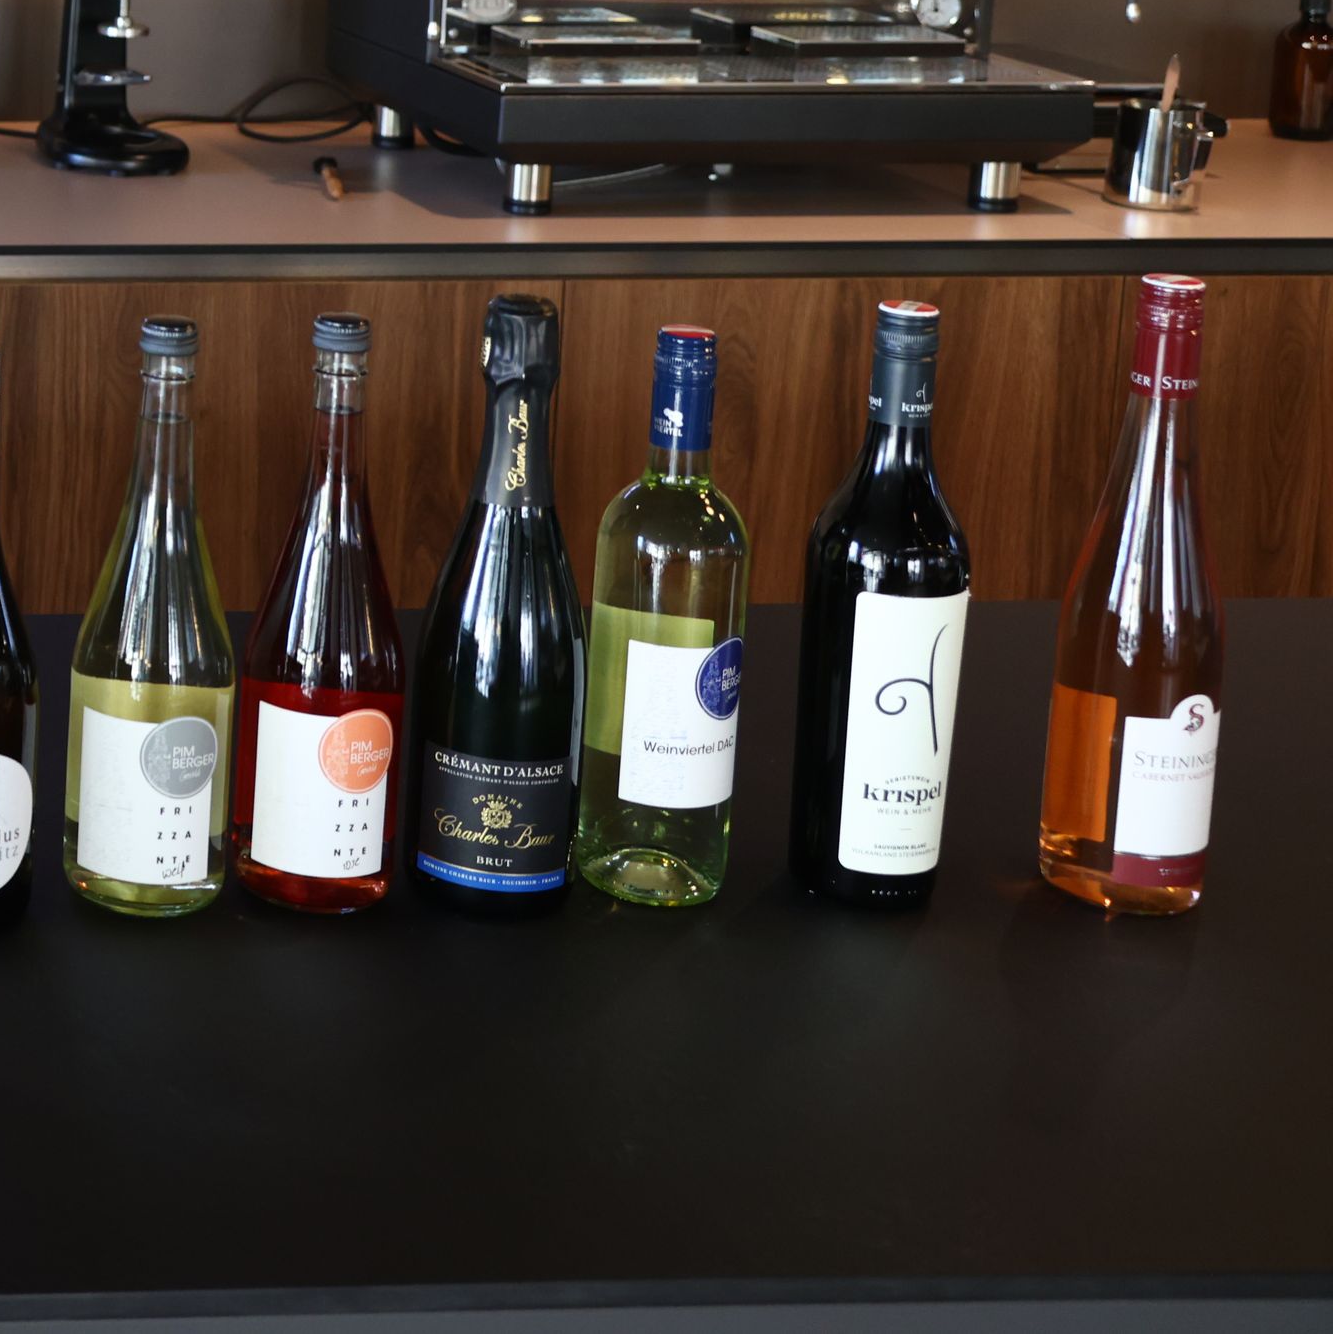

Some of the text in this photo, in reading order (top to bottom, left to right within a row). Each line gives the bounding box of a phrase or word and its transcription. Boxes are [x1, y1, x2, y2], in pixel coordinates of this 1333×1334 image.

[1161, 375, 1198, 391] STEIN
[172, 745, 196, 758] PIM
[350, 740, 373, 752] PIM
[643, 740, 715, 756] Weinviertel
[171, 752, 215, 770] BERGER
[350, 747, 390, 764] BERGER
[434, 751, 564, 778] CRÉMANT D'ALSACE
[471, 793, 524, 810] DOMAINE
[863, 780, 942, 806] krispel
[434, 808, 500, 846] Charles
[476, 855, 513, 868] BRUT
